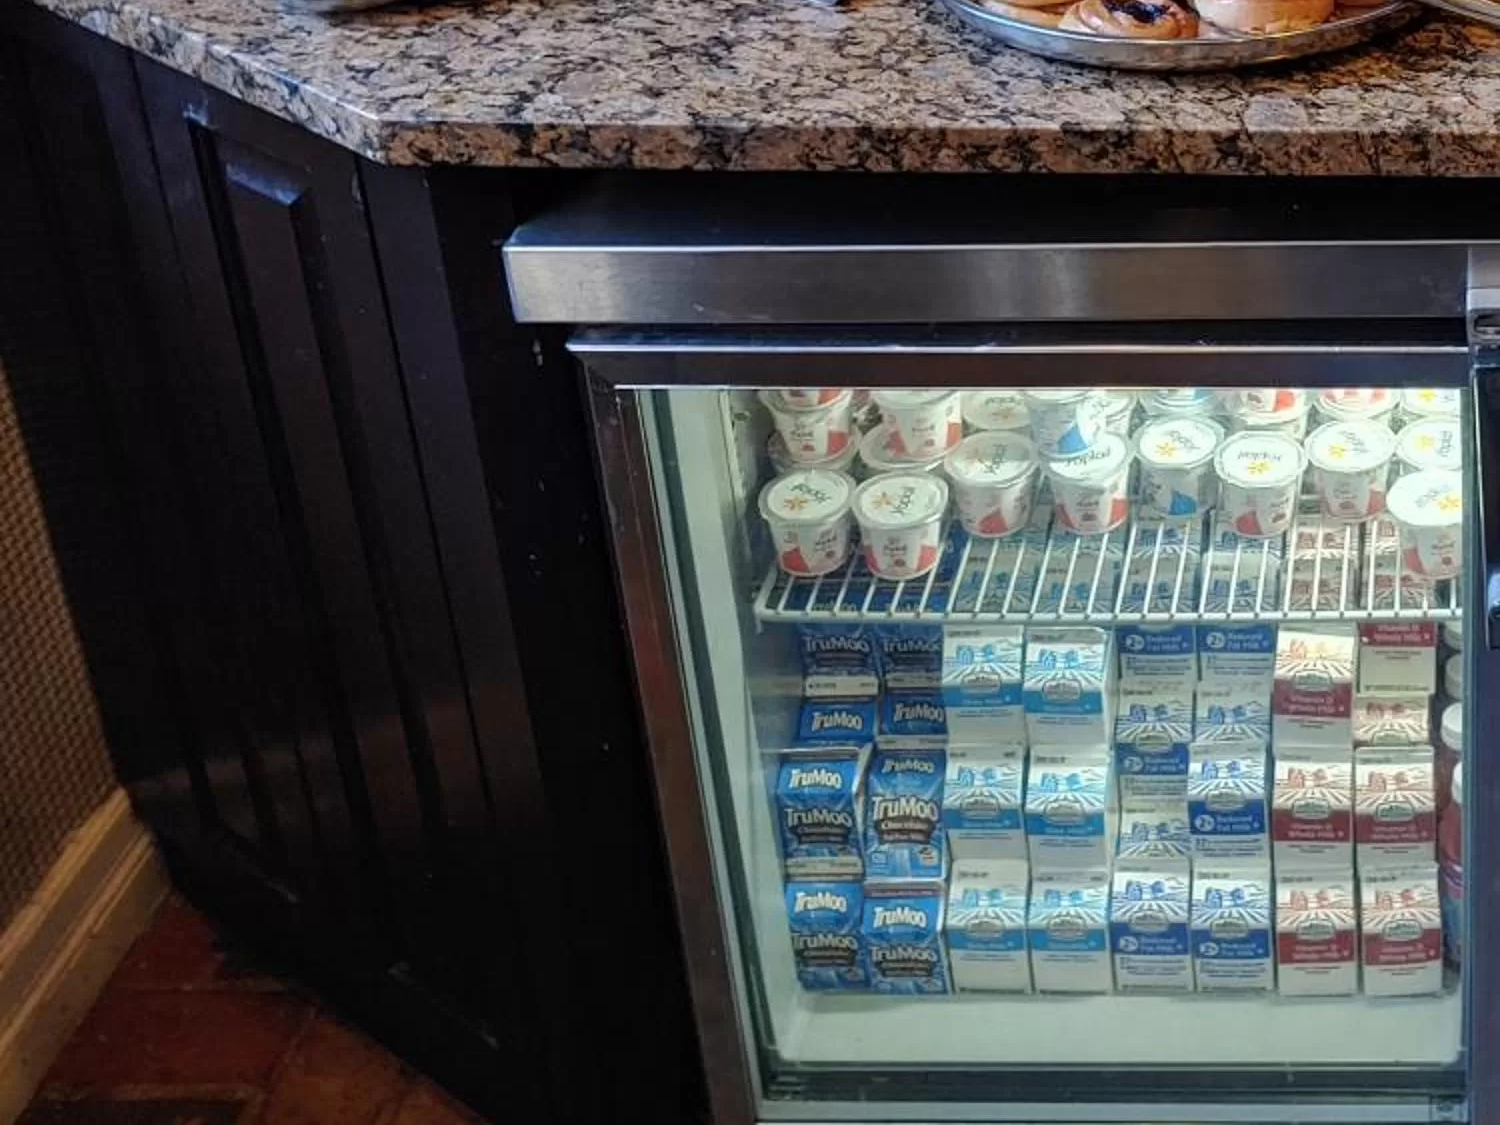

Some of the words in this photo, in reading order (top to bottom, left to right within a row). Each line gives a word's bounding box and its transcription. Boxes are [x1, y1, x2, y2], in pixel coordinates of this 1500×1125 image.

[802, 635, 870, 652] TruMoo
[811, 711, 863, 732] TruMoo
[894, 703, 945, 723] TruMoo
[882, 759, 935, 774] TruMoo
[789, 768, 842, 789] TruMoo
[784, 809, 852, 828] TruMoo
[872, 795, 939, 822] TruMoo
[794, 891, 847, 913] TruMoo
[873, 907, 928, 928] TruMoo
[791, 933, 858, 950] TruMoo
[870, 945, 937, 962] TruMoo
